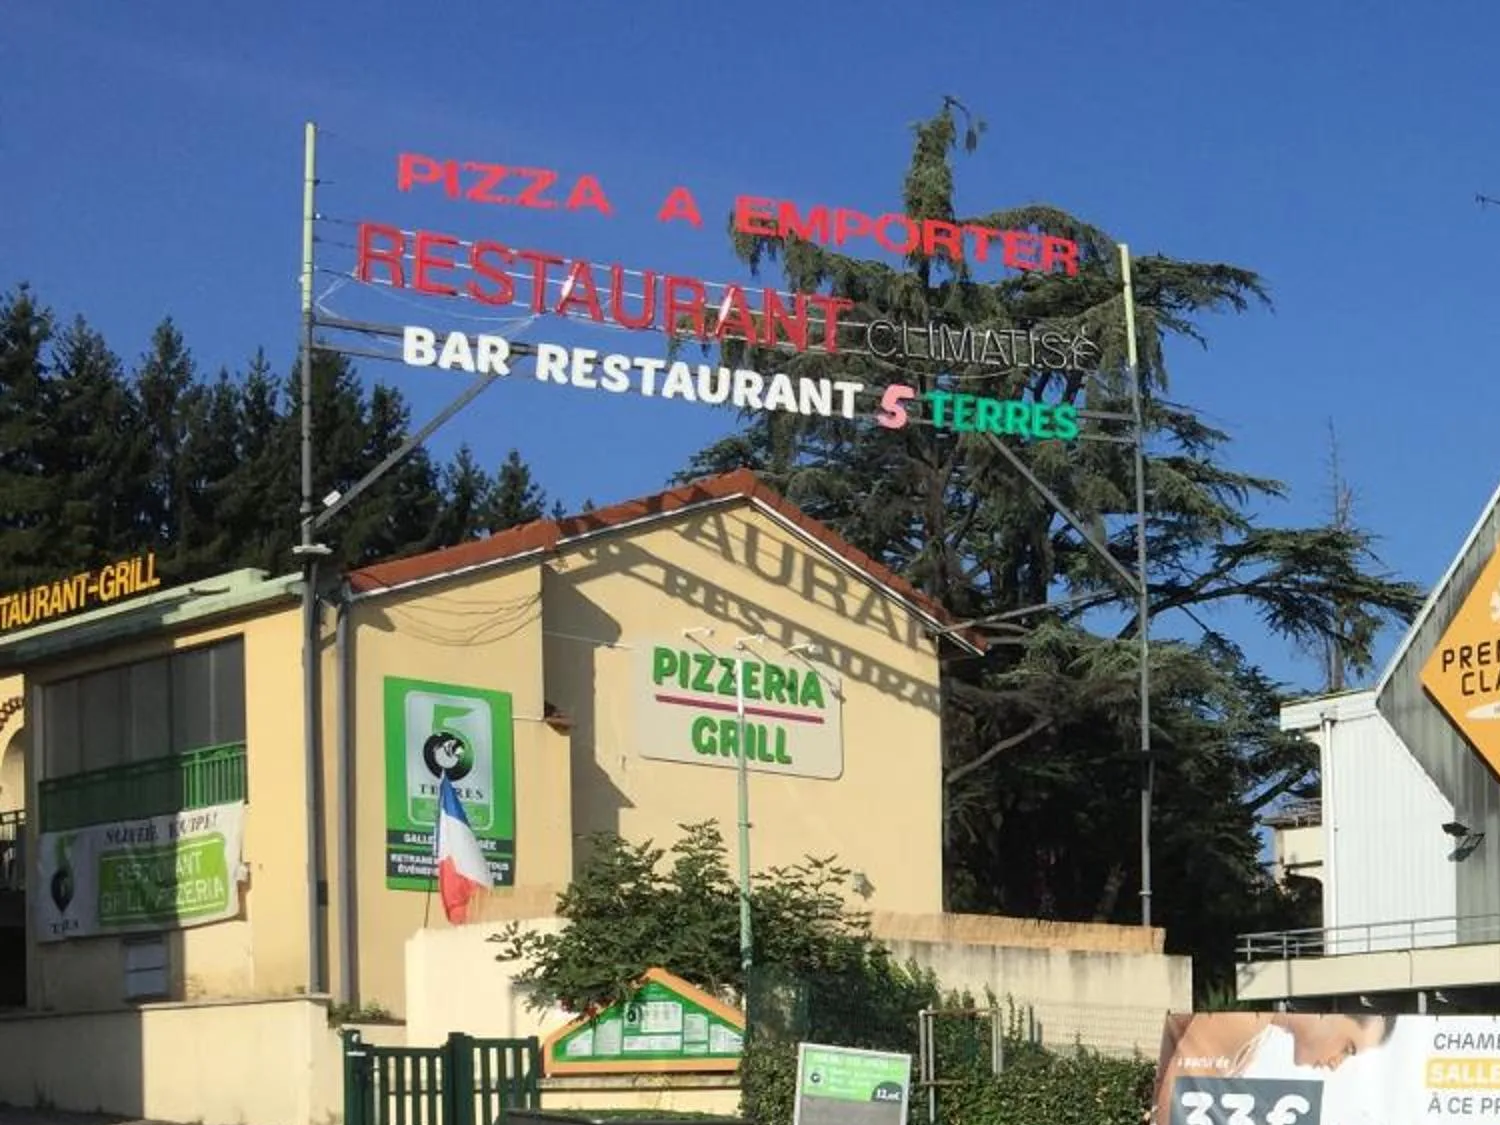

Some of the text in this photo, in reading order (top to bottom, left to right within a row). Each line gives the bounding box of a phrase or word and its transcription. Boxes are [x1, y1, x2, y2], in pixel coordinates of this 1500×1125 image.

[398, 153, 1080, 278] PIZZA A EMPORTER
[357, 222, 853, 354] RESTAURANT
[403, 325, 511, 376] BAR
[535, 342, 864, 419] RESTAURANT
[925, 390, 1081, 442] TERRES
[653, 646, 825, 709] PIZZERIA
[691, 715, 792, 765] GRILL
[1427, 1091, 1442, 1114] À
[1447, 1097, 1473, 1115] CE
